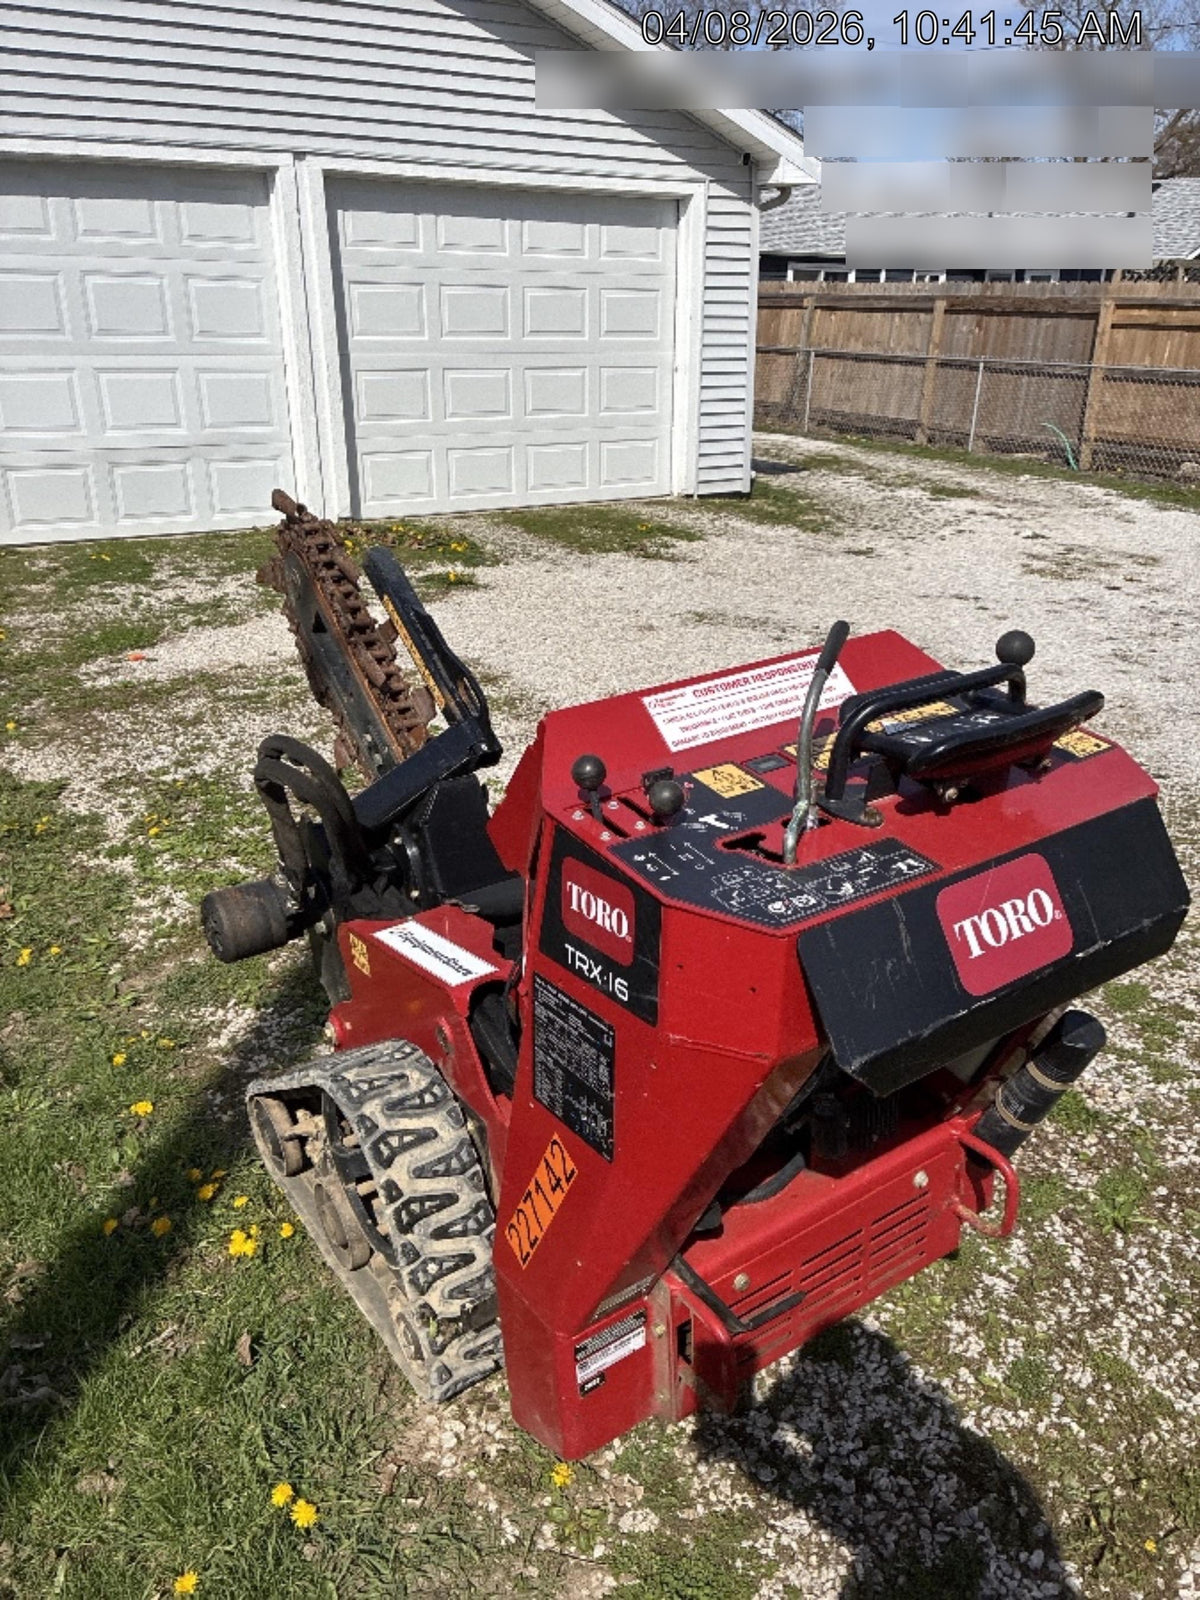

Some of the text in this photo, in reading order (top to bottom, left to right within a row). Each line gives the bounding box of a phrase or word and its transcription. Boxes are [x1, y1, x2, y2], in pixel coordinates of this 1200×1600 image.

[693, 676, 750, 699] CUSTOMER
[566, 881, 630, 939] TORO
[952, 888, 1054, 961] TORO
[506, 1138, 577, 1266] 227142
